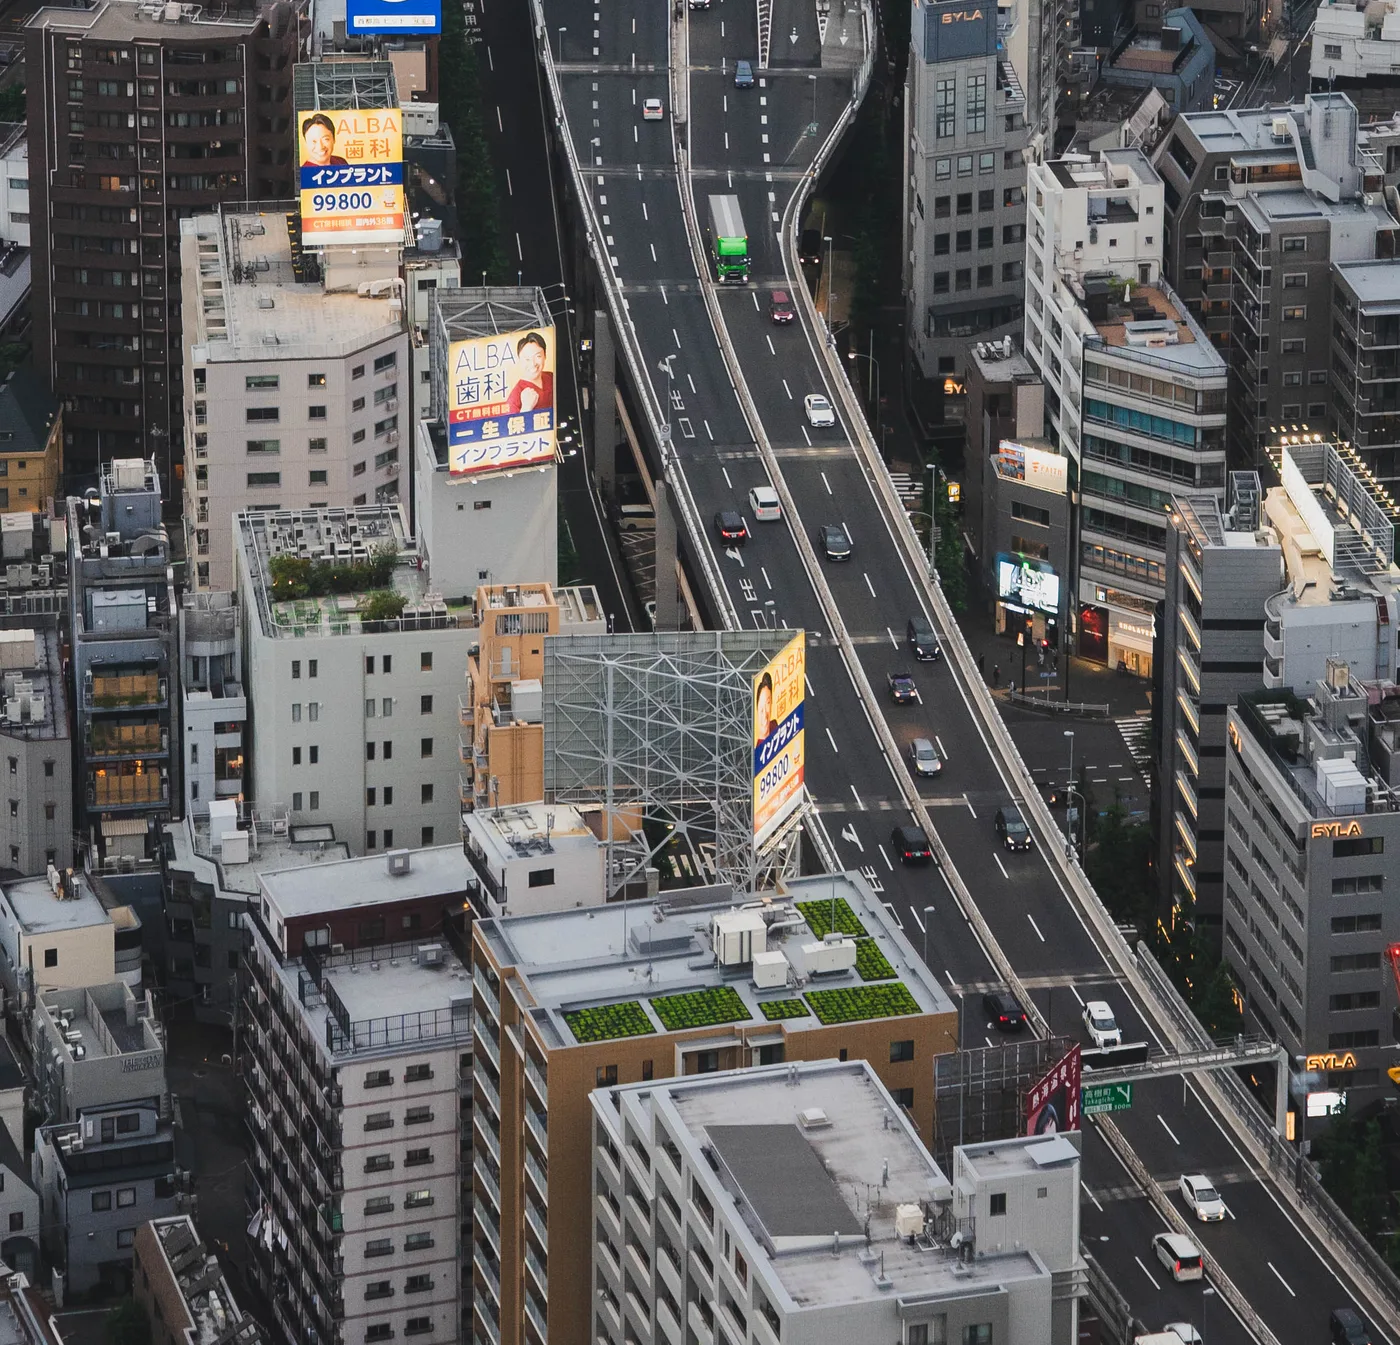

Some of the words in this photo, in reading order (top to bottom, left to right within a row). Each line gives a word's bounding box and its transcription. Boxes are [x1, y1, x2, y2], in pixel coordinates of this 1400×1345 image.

[337, 117, 398, 135] ALBA
[344, 137, 391, 159] 歯科
[312, 166, 393, 185] インプラント
[456, 342, 516, 374] ALBA
[456, 370, 508, 405] 歯科
[772, 647, 804, 689] ALBA
[776, 680, 800, 720] 歯科
[759, 713, 800, 765] インプラント
[1311, 821, 1361, 838] SYLA
[1306, 1052, 1357, 1071] SYLA
